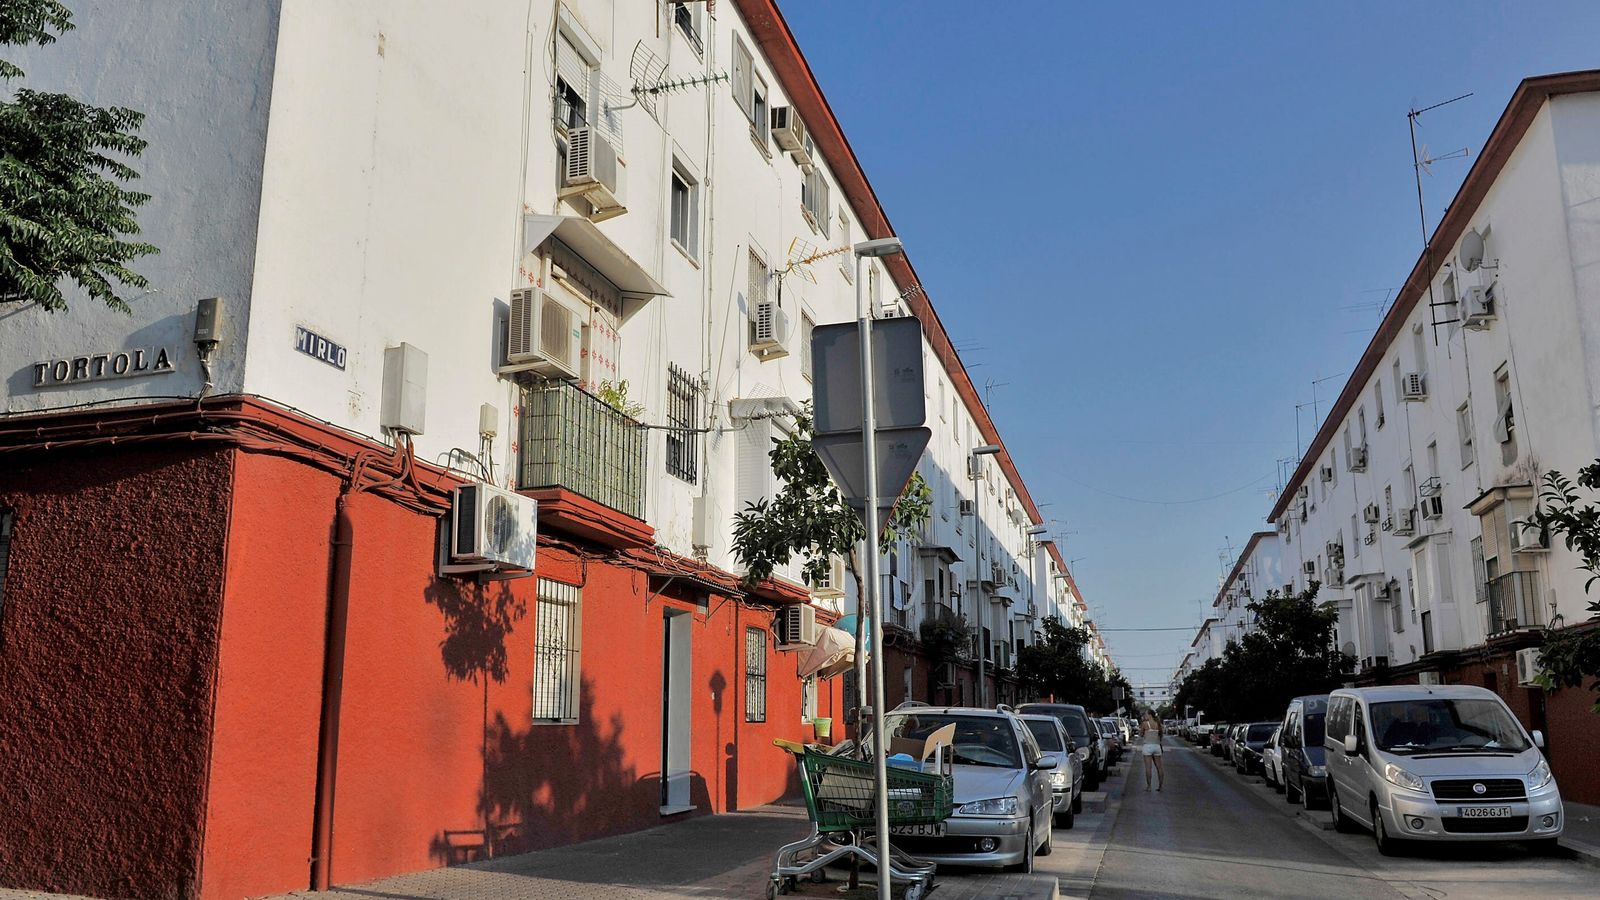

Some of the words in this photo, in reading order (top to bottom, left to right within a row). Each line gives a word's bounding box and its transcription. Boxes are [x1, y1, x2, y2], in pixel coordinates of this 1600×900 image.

[34, 347, 173, 385] TORTOLA
[296, 328, 346, 368] MIRLO
[1464, 808, 1489, 817] 4026
